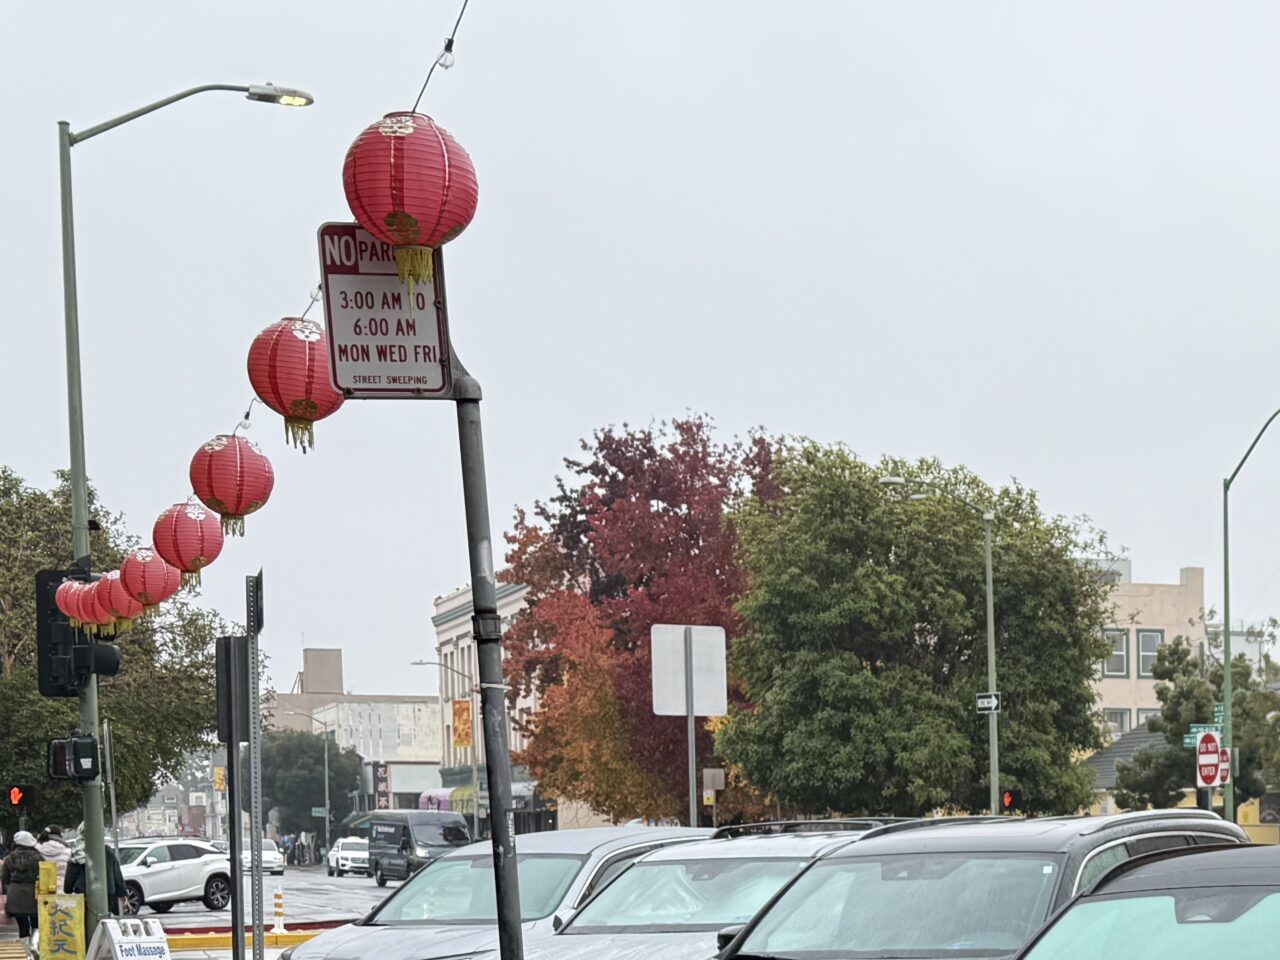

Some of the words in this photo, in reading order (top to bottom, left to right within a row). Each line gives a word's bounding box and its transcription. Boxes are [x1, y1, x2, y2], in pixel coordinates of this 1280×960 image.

[324, 235, 356, 266] NO
[339, 291, 375, 310] 3:00
[381, 292, 401, 311] AM
[406, 293, 425, 310] O
[353, 318, 389, 336] 6:00
[395, 318, 417, 336] AM
[338, 344, 371, 362] MON
[376, 345, 407, 363] WED
[414, 345, 437, 363] FRI
[352, 375, 382, 384] STREET
[386, 375, 428, 385] SWEEPING
[1200, 743, 1207, 752] DO
[1207, 742, 1216, 752] NOT
[1201, 766, 1215, 776] ENTER
[118, 945, 136, 958] Foot
[136, 944, 166, 959] Massage
